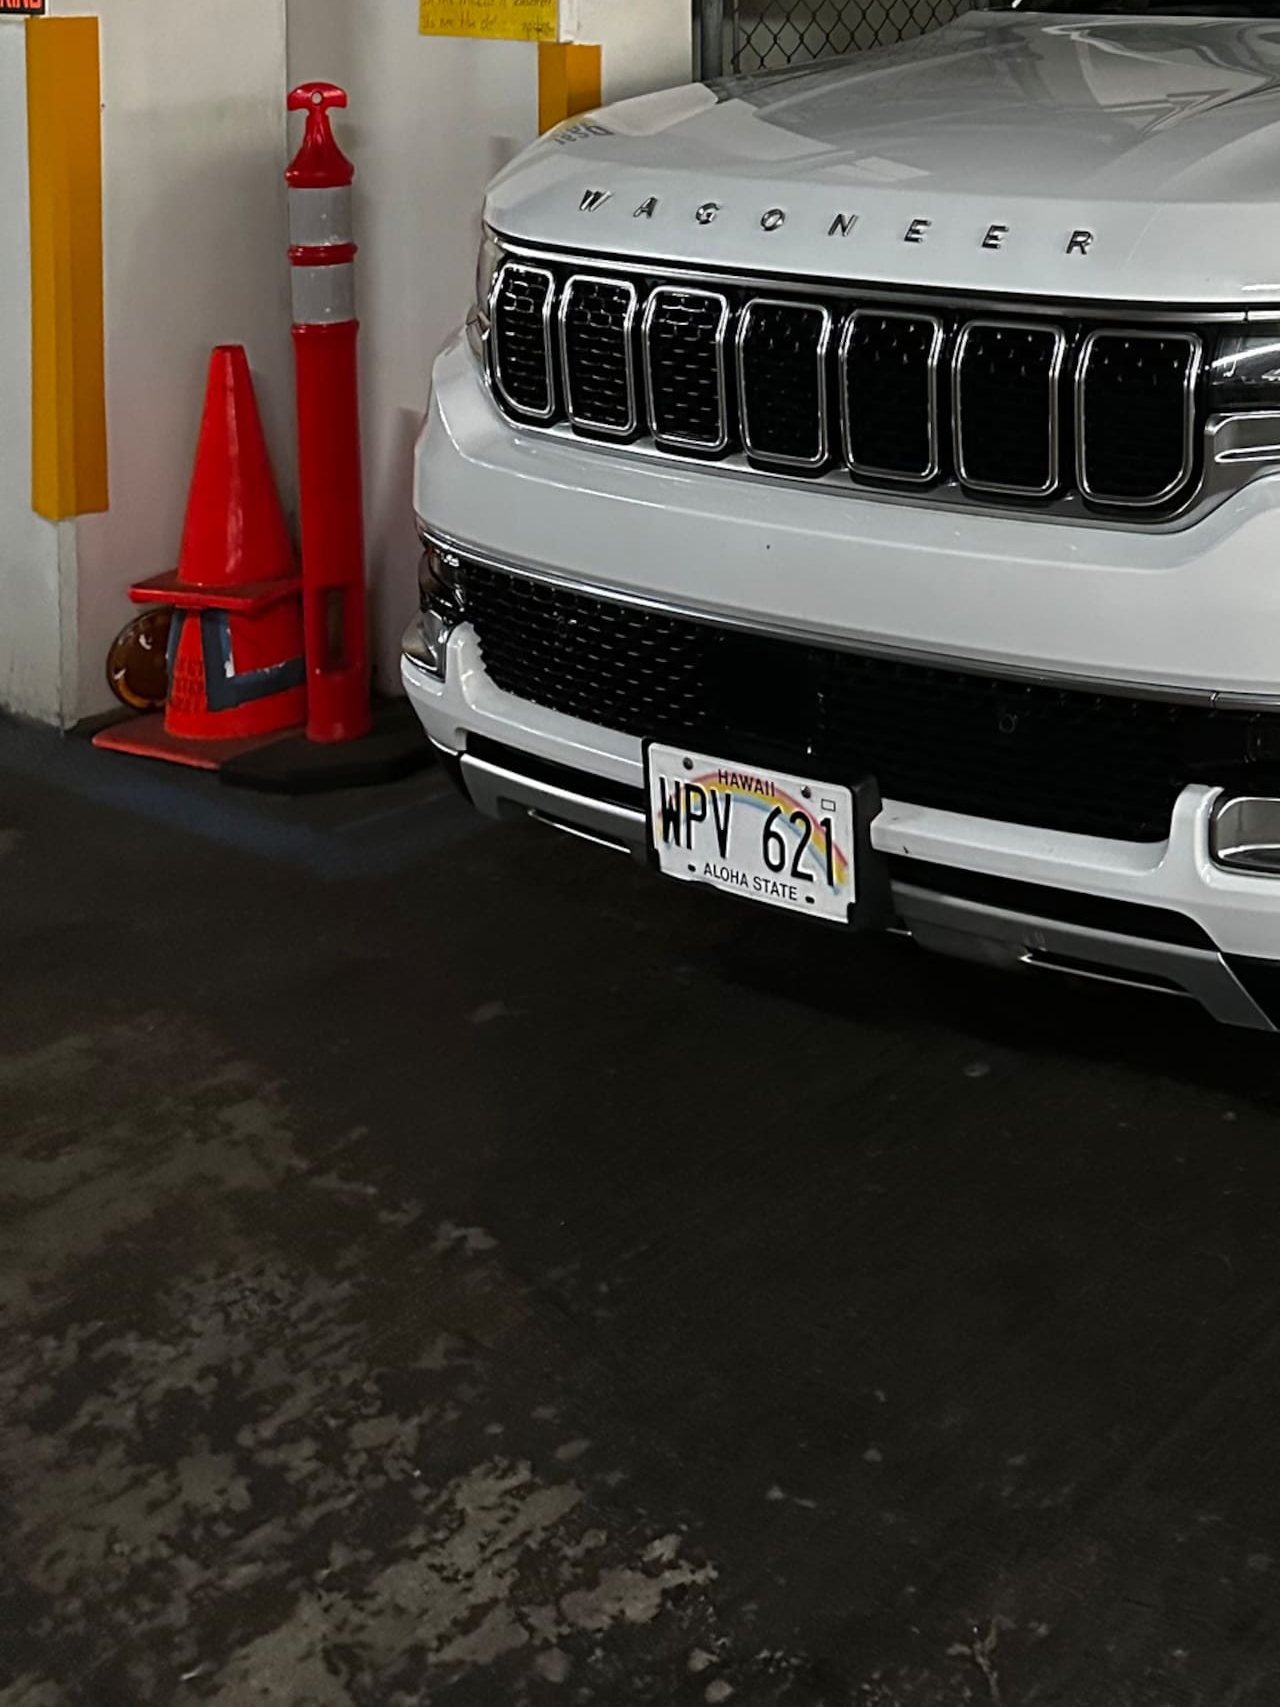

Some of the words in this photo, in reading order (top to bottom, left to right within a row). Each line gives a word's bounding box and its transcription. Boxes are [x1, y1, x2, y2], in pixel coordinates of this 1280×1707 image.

[579, 190, 1094, 255] WAGONEER
[718, 769, 776, 798] HAWAII
[659, 776, 732, 860] WPV
[763, 805, 834, 887] 621
[703, 862, 749, 888] ALOHA
[753, 877, 798, 901] STATE
